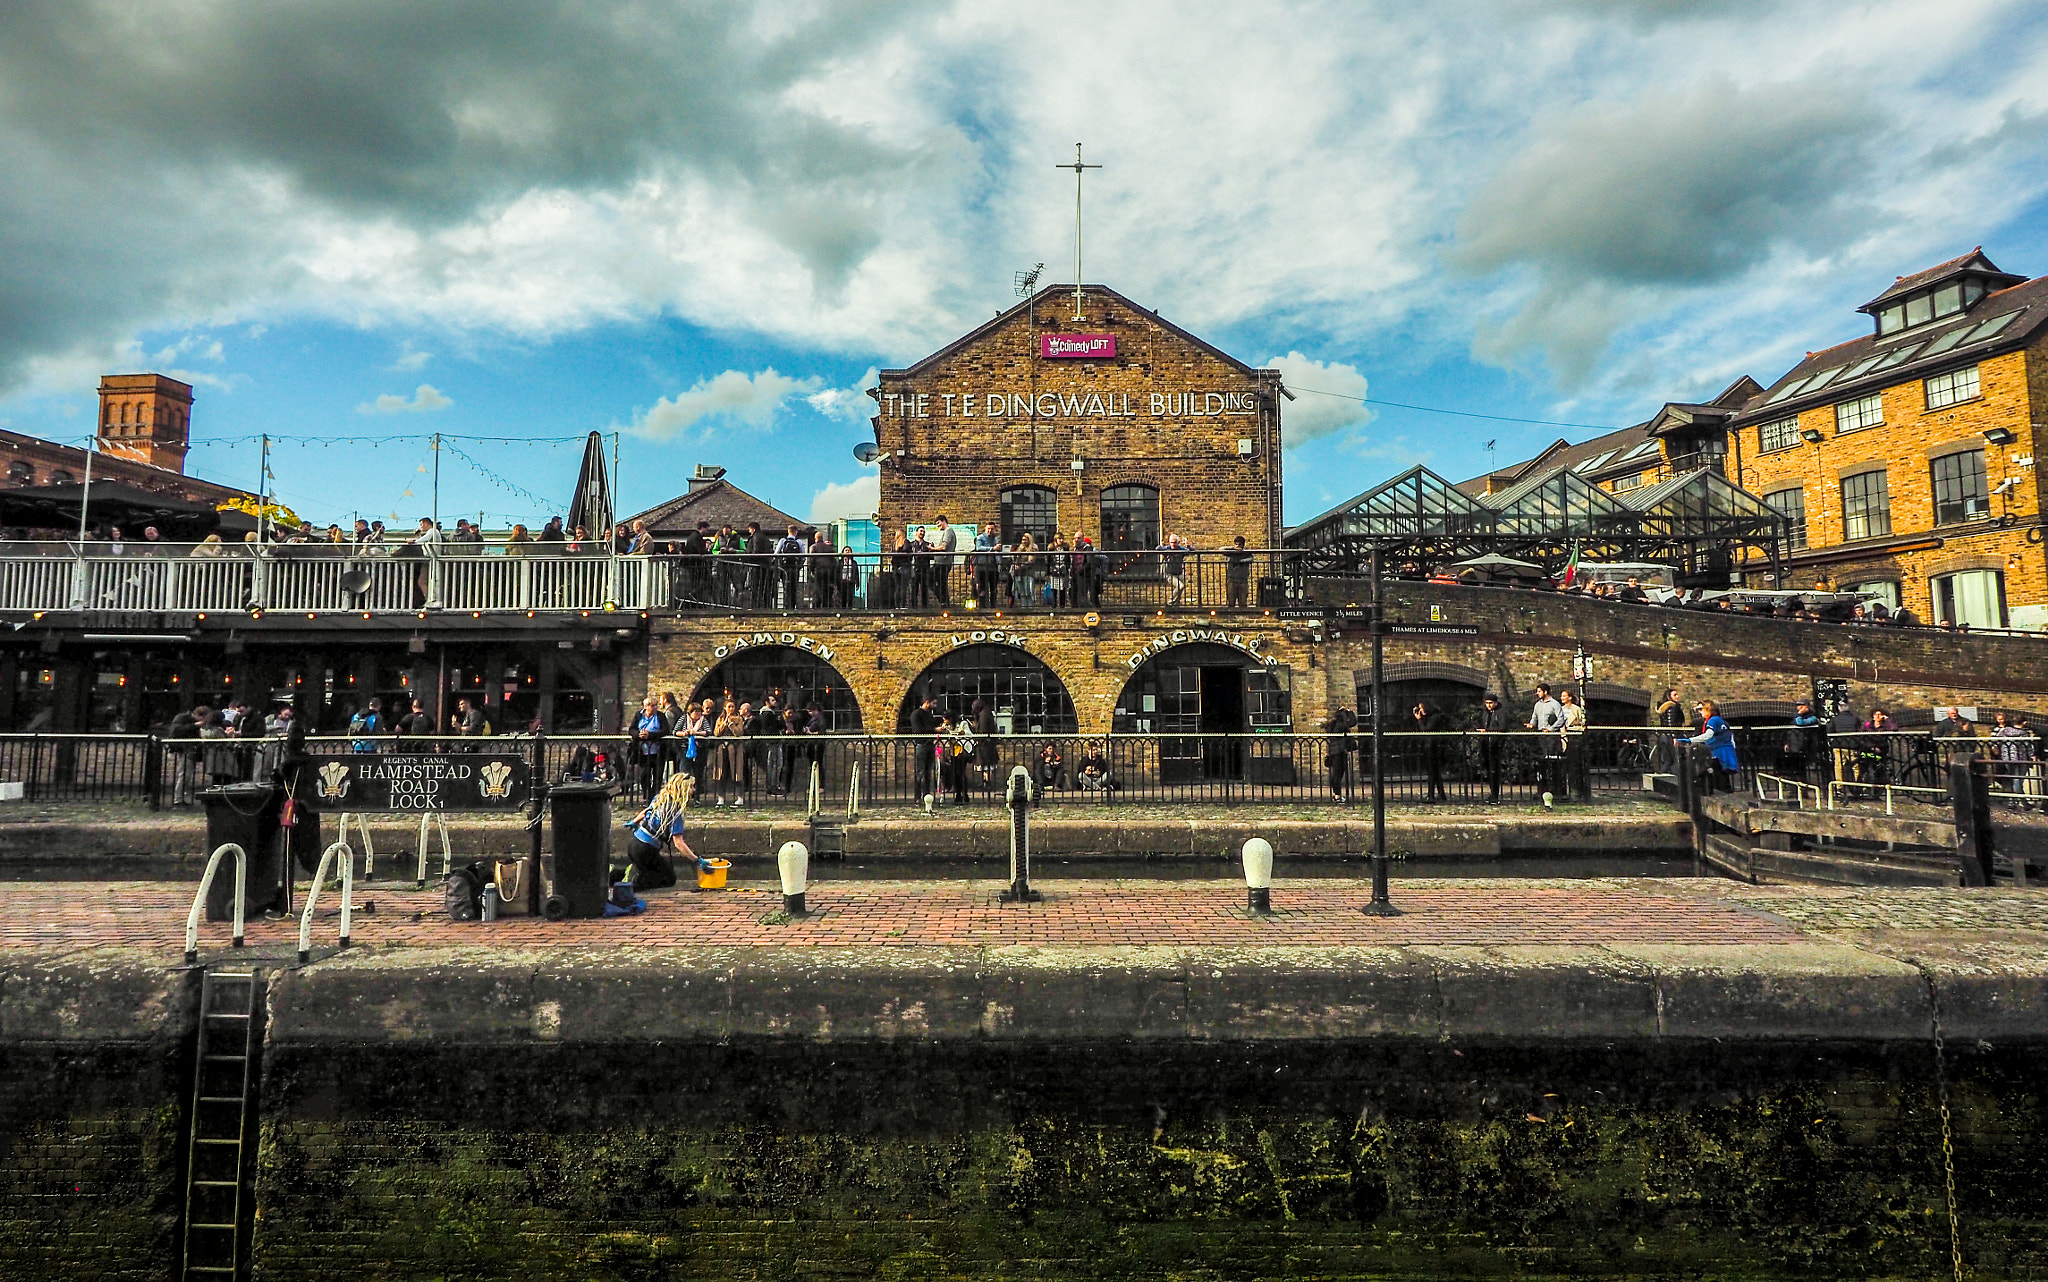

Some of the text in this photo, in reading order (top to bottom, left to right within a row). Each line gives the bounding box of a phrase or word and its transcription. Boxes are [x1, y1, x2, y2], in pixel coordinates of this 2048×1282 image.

[1060, 339, 1109, 354] Comedy LOFT
[884, 393, 930, 418] THE
[987, 392, 1136, 418] DINGWALL
[1150, 392, 1256, 417] BUILDING
[714, 632, 835, 660] CAMDEN
[951, 631, 1027, 647] LOCK
[359, 765, 471, 779] HAMPSTEAD
[390, 780, 439, 794] ROAD
[389, 795, 445, 809] LOCK 1
